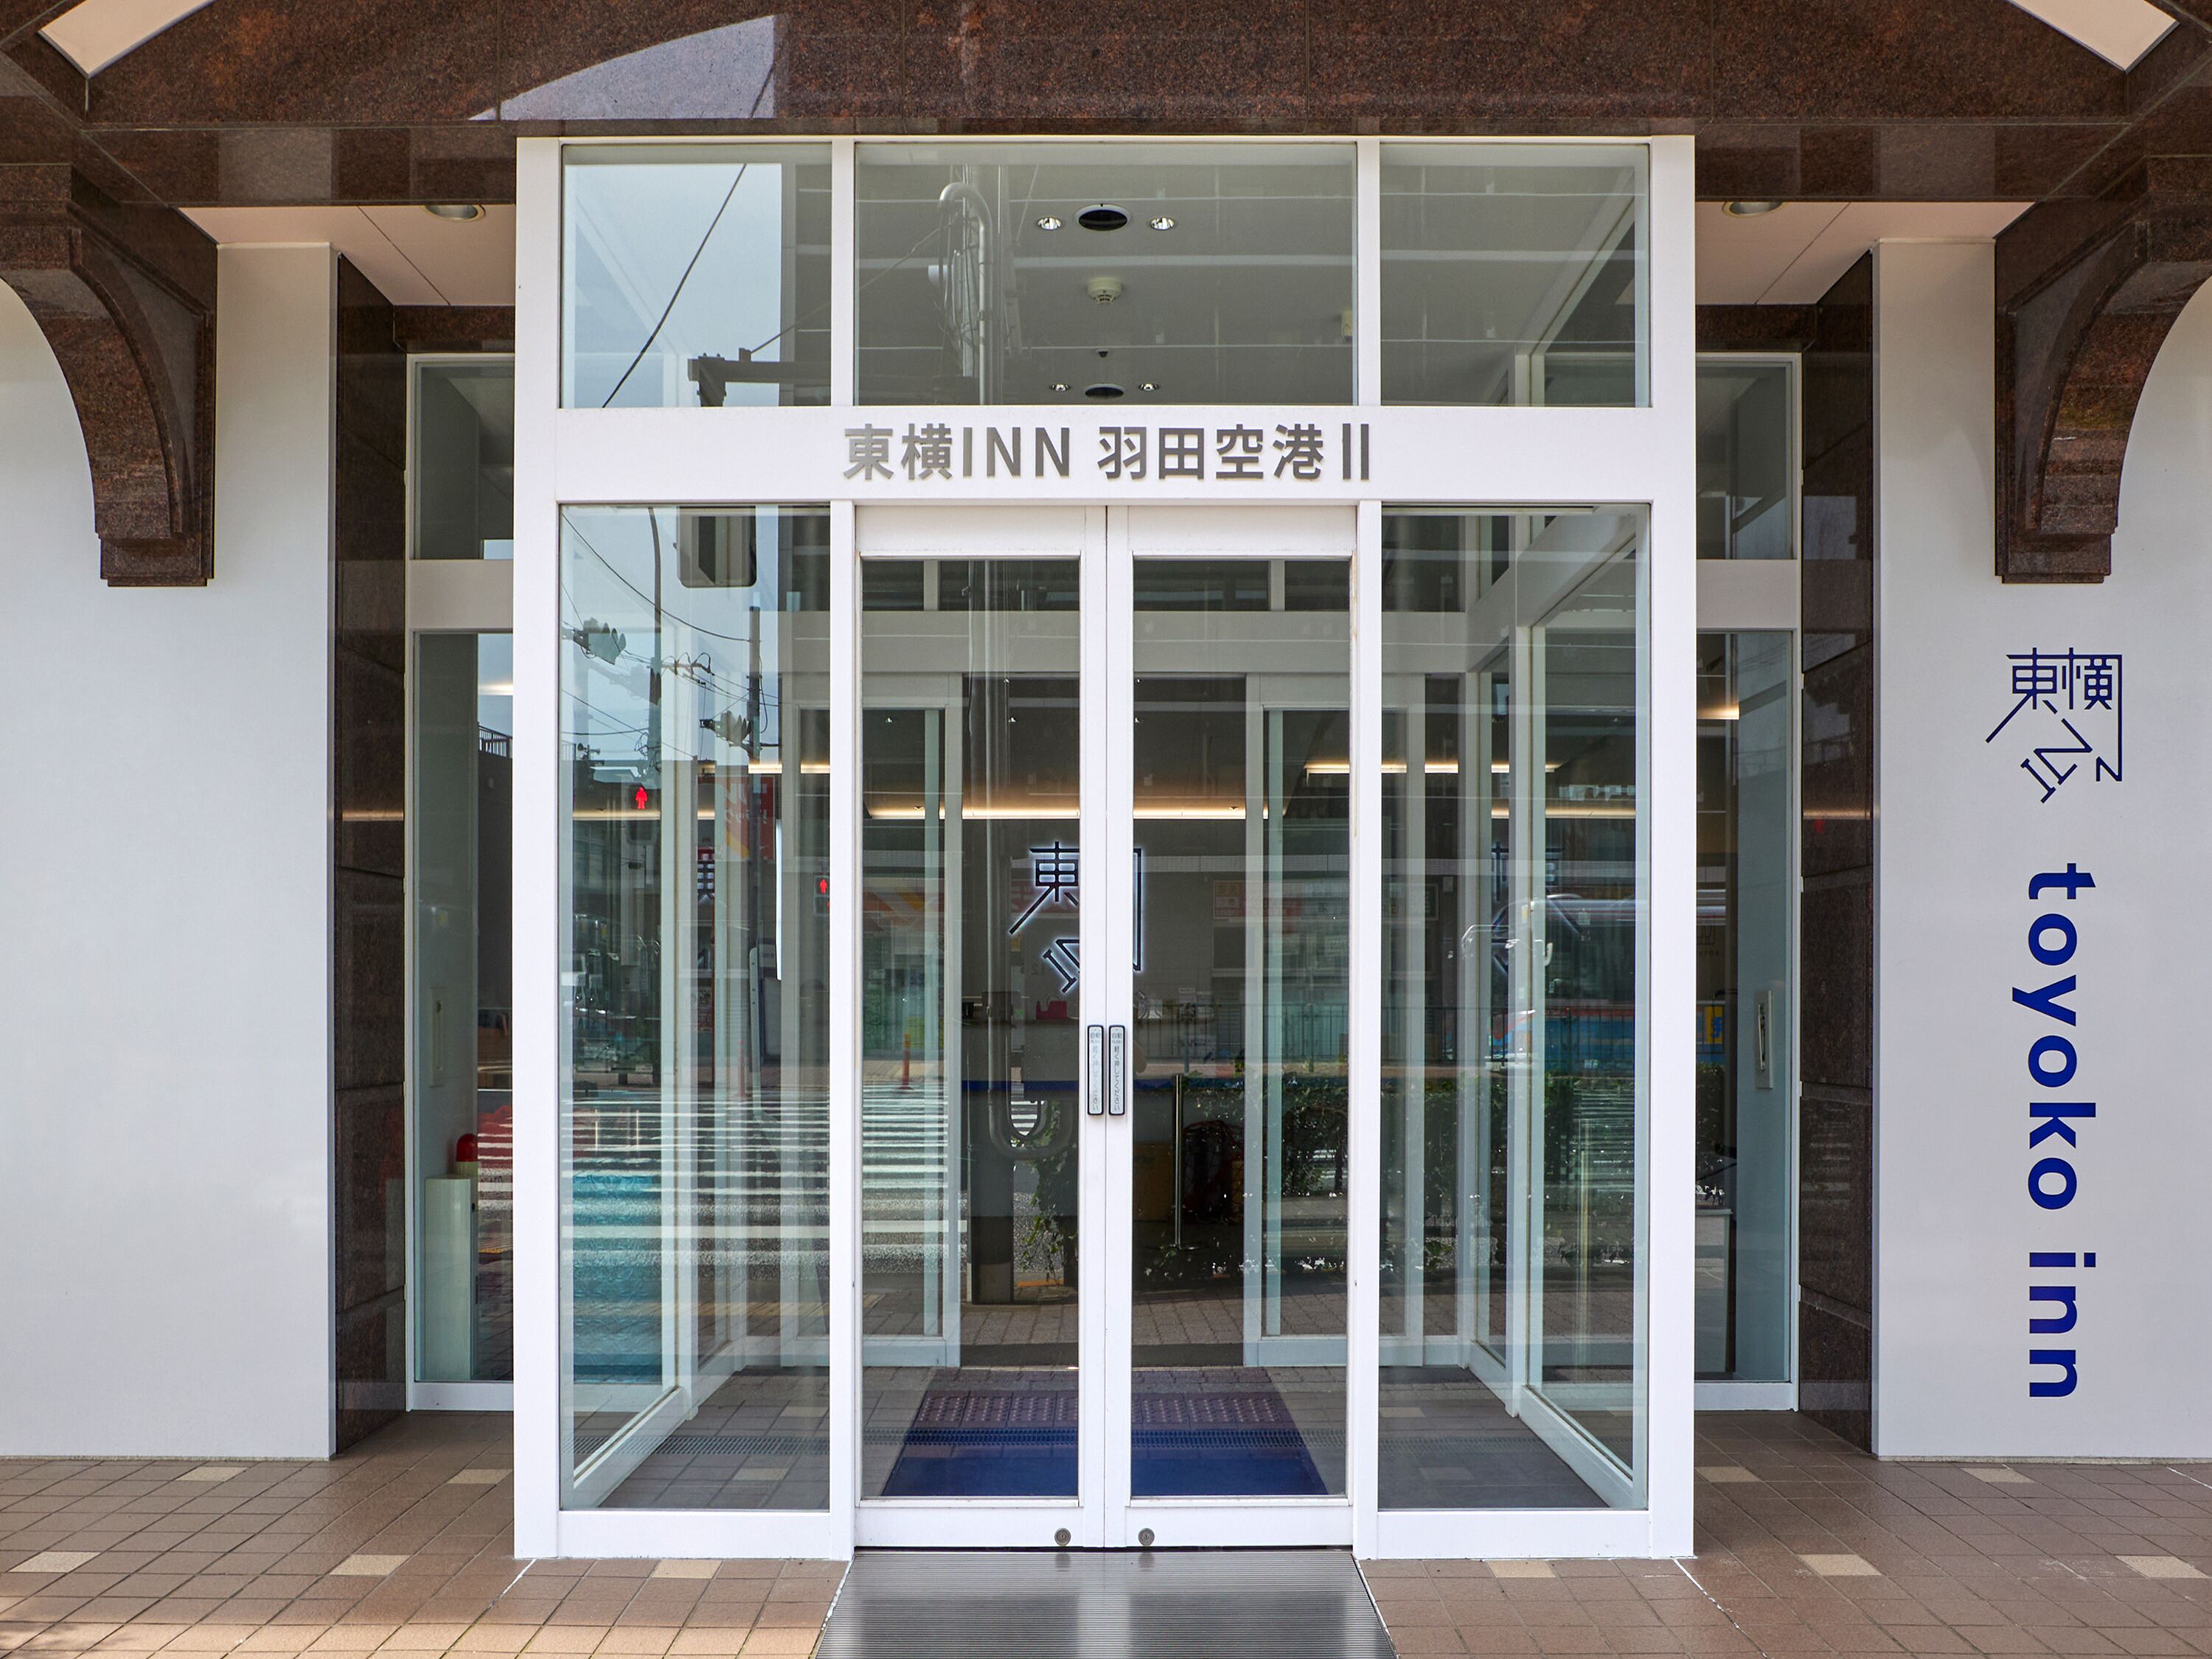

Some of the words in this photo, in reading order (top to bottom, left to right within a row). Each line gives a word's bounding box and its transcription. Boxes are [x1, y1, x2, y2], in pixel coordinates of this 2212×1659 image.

[843, 422, 1071, 481] 東横INN
[2011, 862, 2096, 1211] toyoko
[2028, 1251, 2096, 1398] inn
